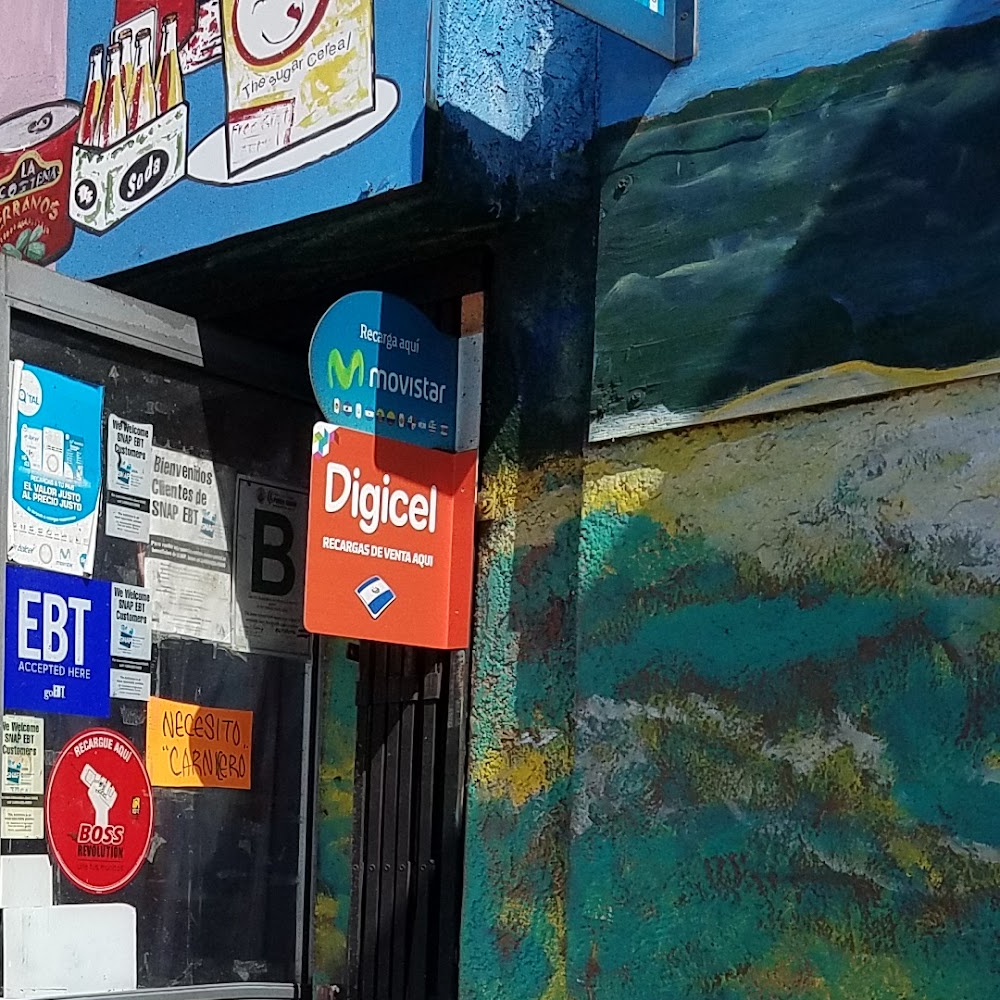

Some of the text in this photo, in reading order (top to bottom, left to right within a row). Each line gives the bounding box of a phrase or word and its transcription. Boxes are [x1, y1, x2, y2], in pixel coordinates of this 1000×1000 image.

[242, 32, 352, 99] The sugar Cereal
[20, 161, 36, 178] LA
[126, 155, 161, 199] Soda
[360, 323, 420, 356] Recarga aquí
[369, 366, 446, 404] movistar
[153, 454, 213, 485] Bienvenidos
[21, 490, 83, 512] AL PRECIO JUSTO
[23, 480, 82, 503] EL VALOR JUSTO
[151, 478, 194, 503] Clientes
[324, 461, 437, 534] Digicel
[151, 500, 179, 521] SNAP
[182, 506, 199, 526] EBT
[251, 508, 296, 597] B
[322, 536, 434, 569] RECARGAS DE VENTA AQUI
[114, 587, 150, 602] We Welcome
[18, 589, 91, 665] EBT
[116, 610, 147, 624] Customers
[18, 661, 90, 679] ACCEPTED HERE
[4, 733, 34, 744] SNAP EBT
[12, 722, 40, 733] Welcome
[162, 710, 240, 746] NECESITO
[2, 745, 37, 756] Customers
[73, 737, 114, 758] RECARGUE
[77, 822, 125, 846] BOSS
[77, 845, 124, 859] REVOLUTION
